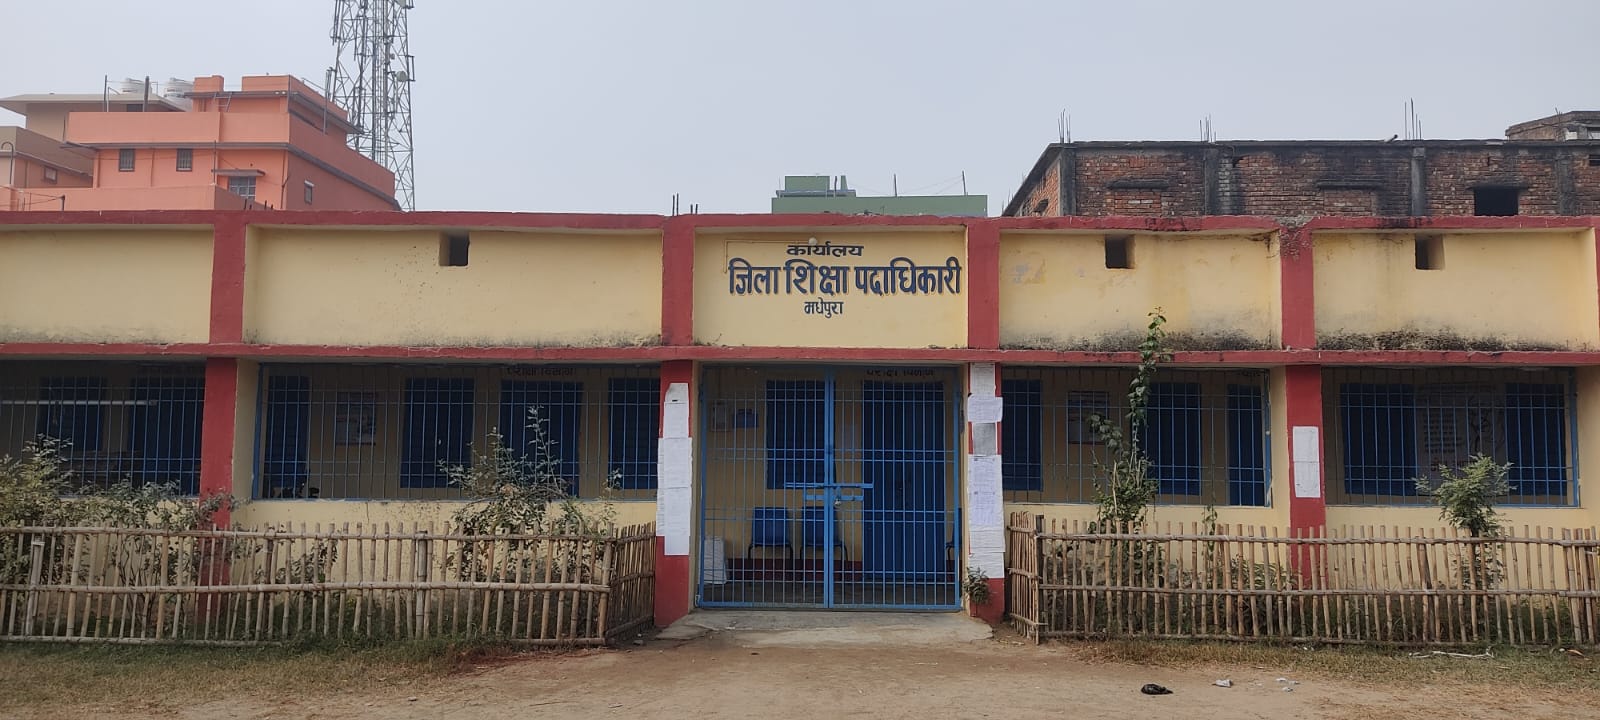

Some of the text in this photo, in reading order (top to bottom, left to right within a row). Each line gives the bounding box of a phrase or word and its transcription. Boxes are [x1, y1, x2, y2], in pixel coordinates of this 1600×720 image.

[786, 241, 864, 257] कार्यालय
[728, 256, 962, 296] जिला शिक्षा पदाधिकारी
[804, 297, 844, 318] मधेपुरा
